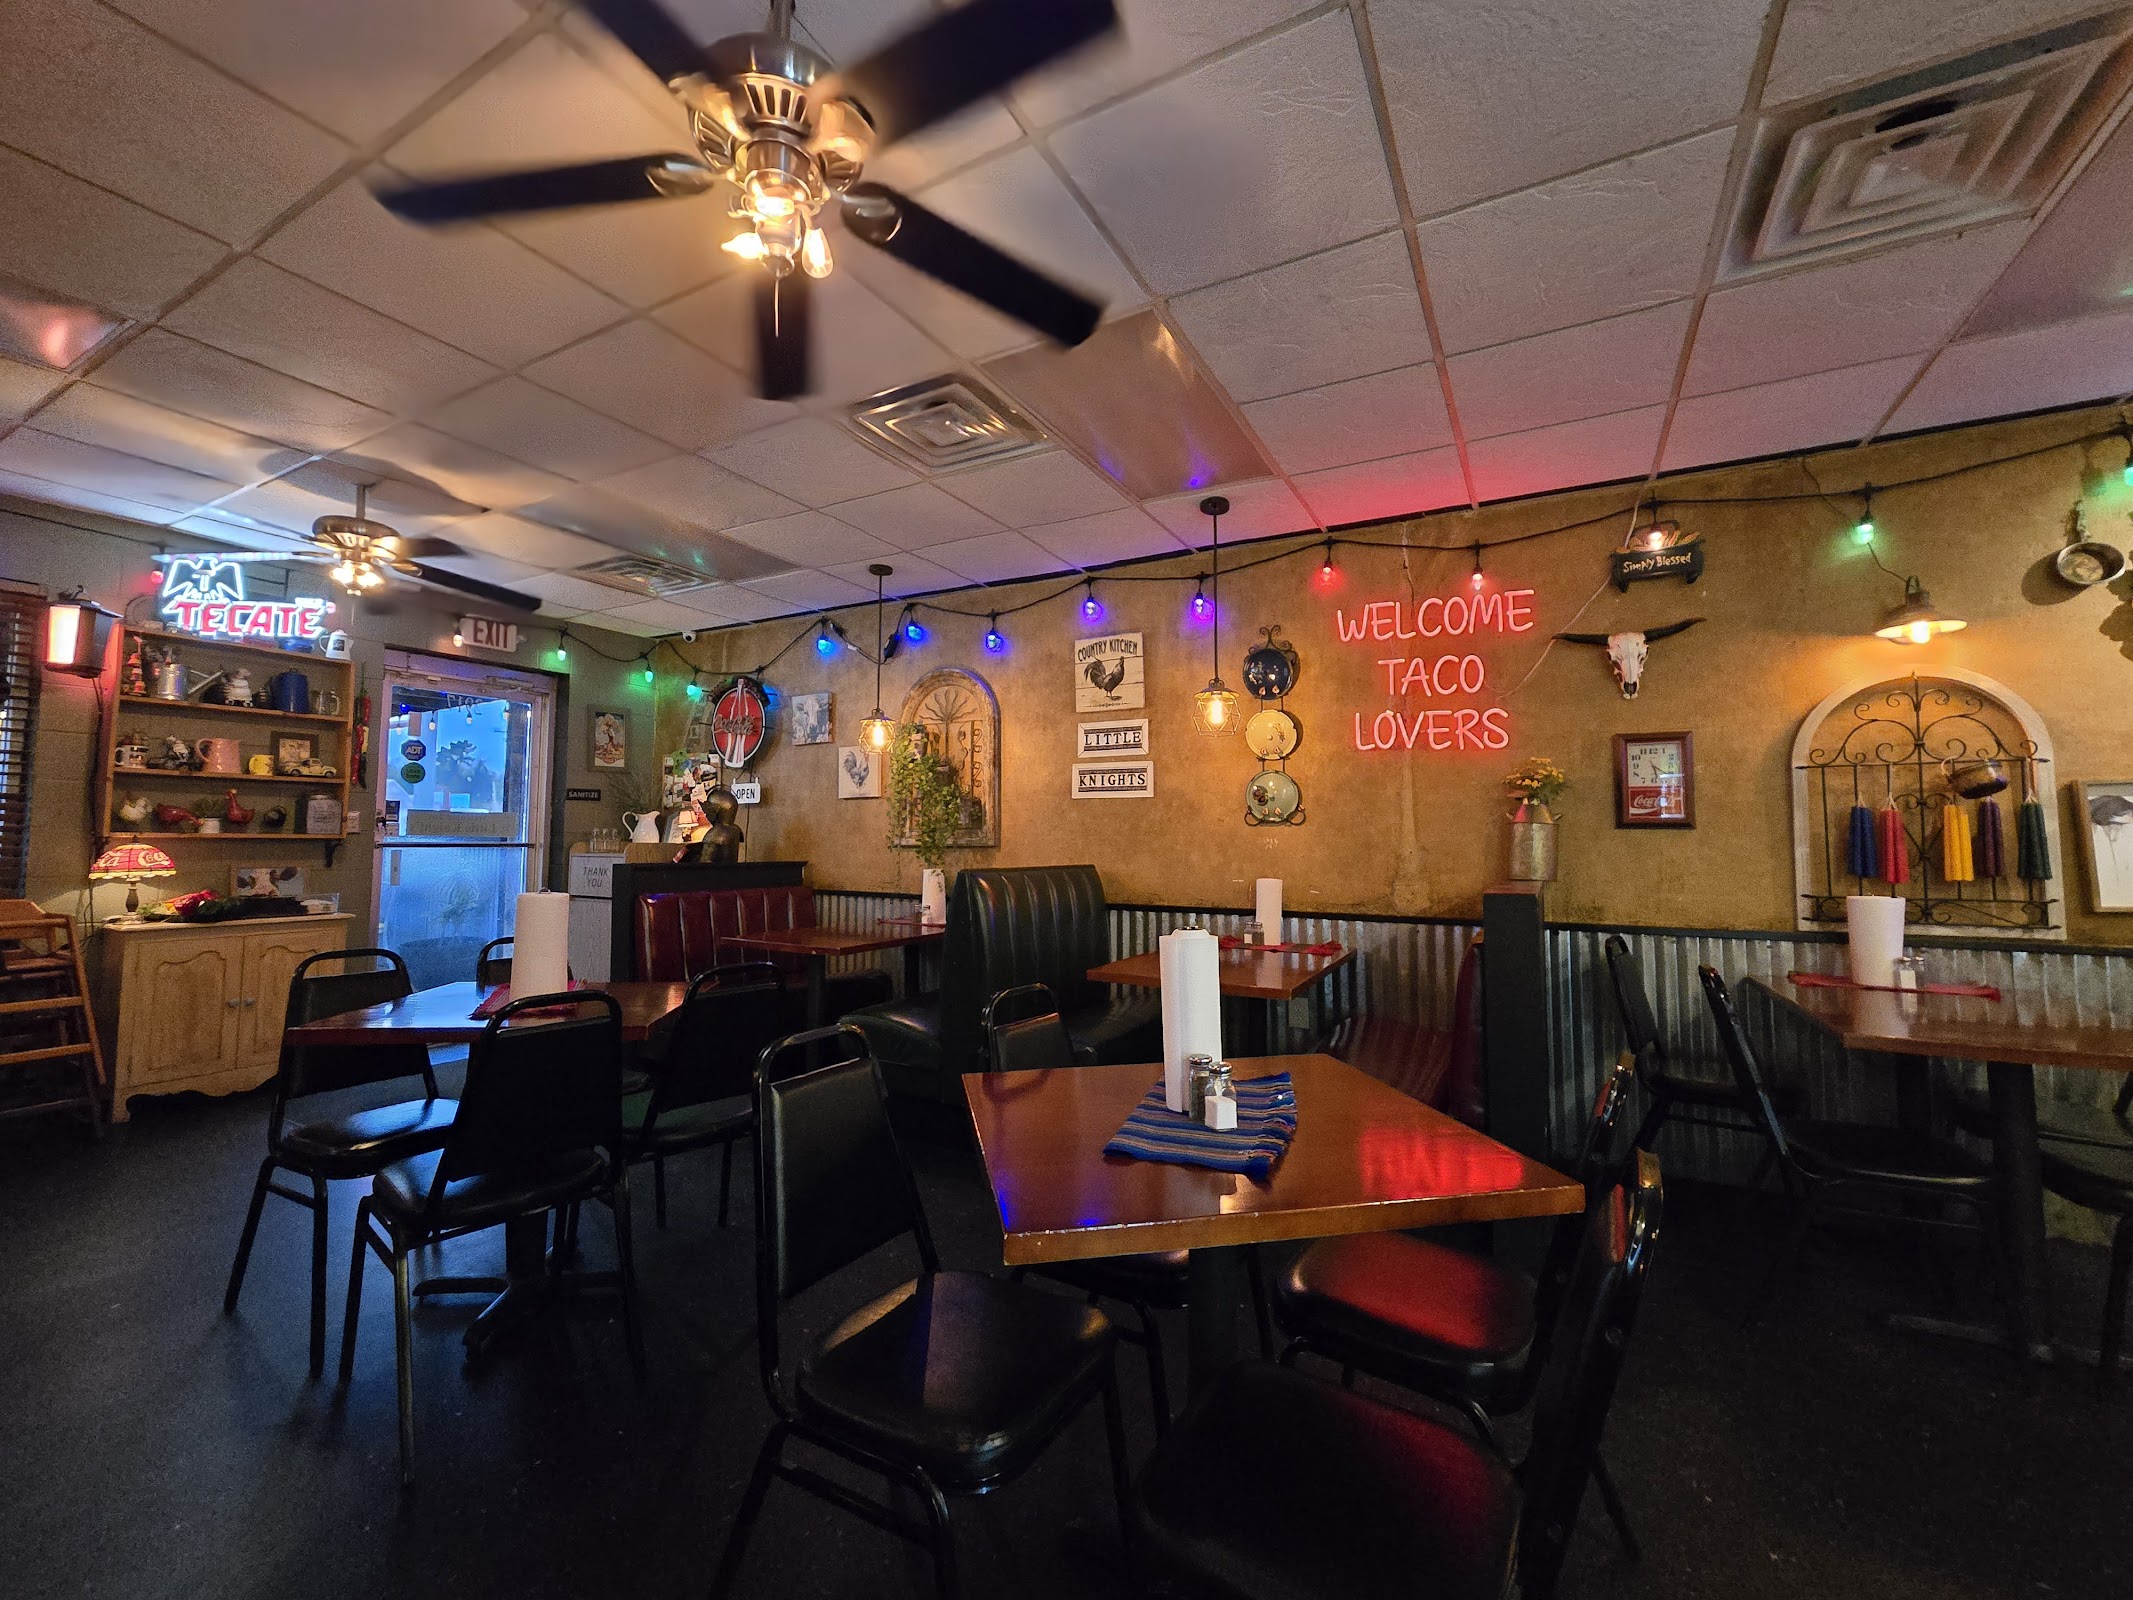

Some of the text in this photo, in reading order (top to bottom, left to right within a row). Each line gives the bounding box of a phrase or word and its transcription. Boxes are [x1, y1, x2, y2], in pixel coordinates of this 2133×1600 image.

[1623, 552, 1691, 573] Simply Blessed
[171, 600, 322, 638] TECATE
[1337, 589, 1535, 642] WELCOME
[473, 620, 512, 649] EXIT
[1077, 638, 1138, 662] COUNTRY KITCHEN
[1377, 654, 1485, 697] TACO
[1355, 708, 1509, 750] LOVERS
[1085, 732, 1142, 746] LITTLE
[405, 745, 423, 755] ADT
[1079, 773, 1146, 787] KNIGHTS
[568, 790, 599, 798] SANITIZE
[736, 788, 756, 800] OPEN
[583, 866, 609, 877] THANK
[586, 878, 603, 888] YOU
